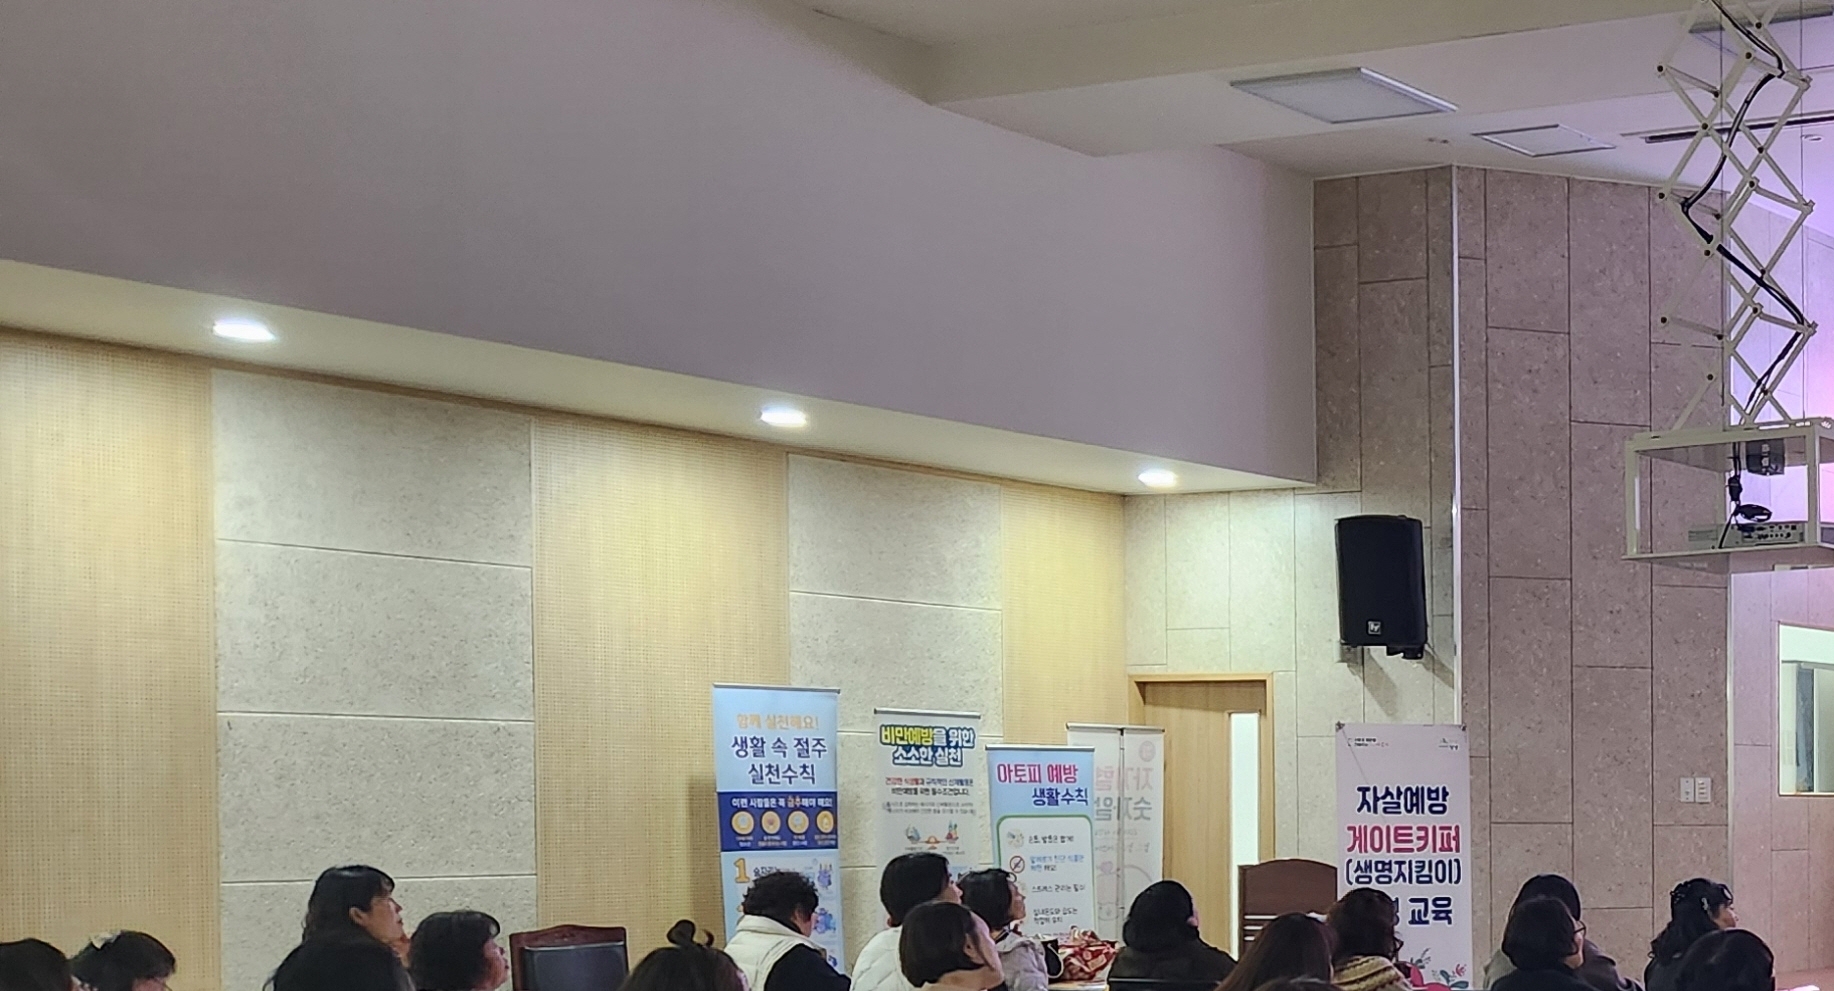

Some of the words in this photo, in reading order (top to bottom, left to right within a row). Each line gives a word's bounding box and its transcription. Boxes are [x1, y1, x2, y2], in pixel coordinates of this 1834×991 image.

[731, 735, 766, 759] 생활
[770, 737, 789, 759] 속
[793, 737, 828, 759] 절주
[880, 725, 947, 746] 비만예방을
[948, 727, 975, 748] 위한
[893, 746, 933, 765] 소소한
[935, 747, 963, 766] 실천
[748, 763, 817, 786] 실천수칙
[996, 763, 1042, 784] 아토피
[1047, 763, 1079, 784] 예방
[1031, 787, 1089, 807] 생활수칙
[1356, 785, 1450, 815] 자살예방
[1346, 825, 1461, 854] 게이트키퍼
[733, 858, 750, 884] 1
[1345, 858, 1462, 885] (생명지킴이)
[1408, 896, 1453, 925] 교육
